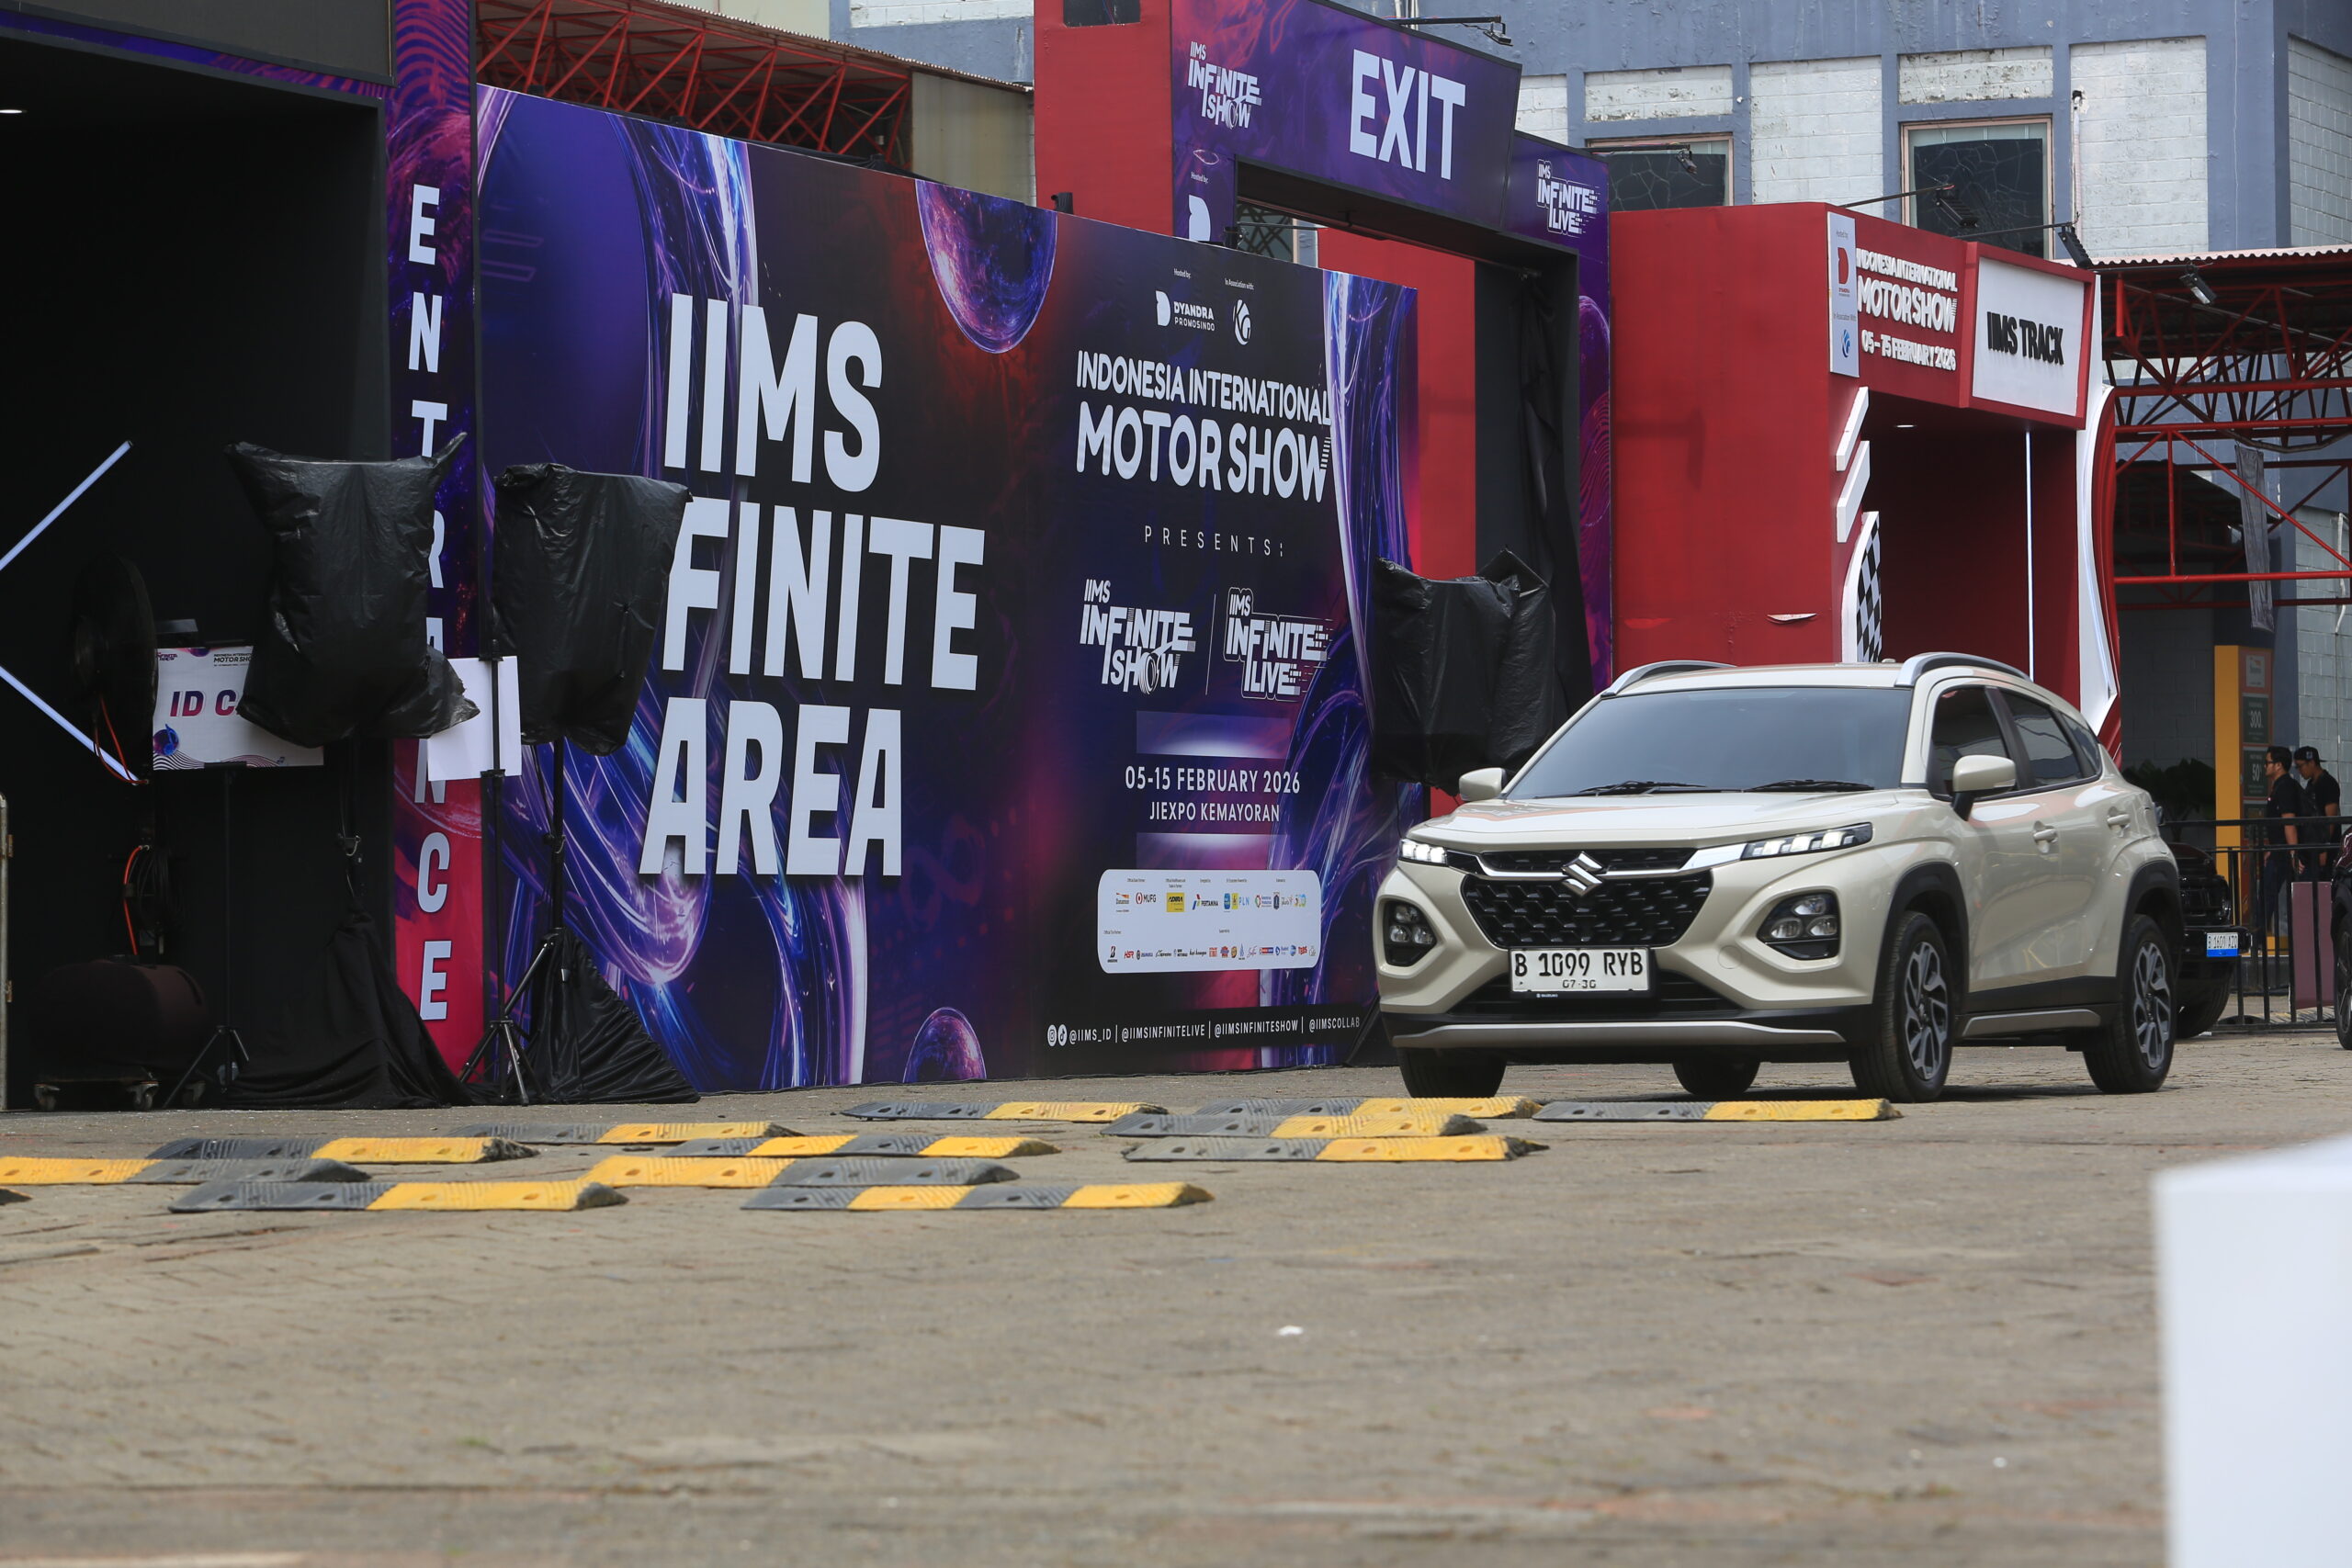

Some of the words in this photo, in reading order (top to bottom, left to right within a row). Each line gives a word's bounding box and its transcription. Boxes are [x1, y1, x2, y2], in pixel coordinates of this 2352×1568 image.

[1190, 40, 1206, 61] IIMS
[1188, 58, 1262, 107] INFINITE
[1204, 94, 1251, 130] SHOW
[1350, 49, 1465, 181] EXIT
[1538, 164, 1551, 180] IIMS
[1537, 178, 1598, 215] INFINITE
[1551, 208, 1582, 234] LIVE
[1856, 247, 1897, 278] INDONESIA
[1897, 258, 1958, 293] INTERNATIONAL
[1173, 301, 1215, 320] DYANDRA
[1174, 316, 1216, 332] PROMOSINDO
[1892, 337, 1936, 367] FEBRUARY
[1935, 345, 1956, 371] 2026
[1986, 310, 2018, 356] IIMS
[2018, 318, 2064, 366] TRACK
[663, 292, 883, 492] IIMS
[1077, 350, 1185, 404] INDONESIA
[1189, 367, 1332, 426] INTERNATIONAL
[1077, 401, 1222, 491] MOTOR
[1227, 423, 1331, 503] SHOW
[1145, 525, 1283, 558] PRESENTS:
[1084, 579, 1112, 604] IIMS
[1229, 593, 1251, 616] IIMS
[1080, 604, 1195, 652] INFINITE
[1227, 617, 1329, 661] INFINITE
[1107, 649, 1181, 694] SHOW
[1248, 661, 1301, 696] LIVE
[170, 690, 204, 717] ID
[639, 696, 902, 876] AREA
[1125, 766, 1170, 790] 05-15
[1177, 768, 1258, 793] FEBRUARY
[1263, 771, 1300, 794] 2026
[1149, 801, 1196, 821] JIEXPO
[1201, 803, 1280, 822] KEMAYORAN
[1143, 894, 1157, 903] MUFG
[1238, 896, 1250, 907] PLN
[1515, 953, 1528, 976] B
[1538, 953, 1590, 976] 1099
[1603, 952, 1644, 976] RYB
[1069, 1028, 1112, 1045] @IIMS_ID
[1121, 1024, 1205, 1043] @IIMSINFINITELIVE
[1215, 1019, 1298, 1038] @IIMSINFINITESHOW
[1309, 1017, 1361, 1033] @IIMSCOLLAB
